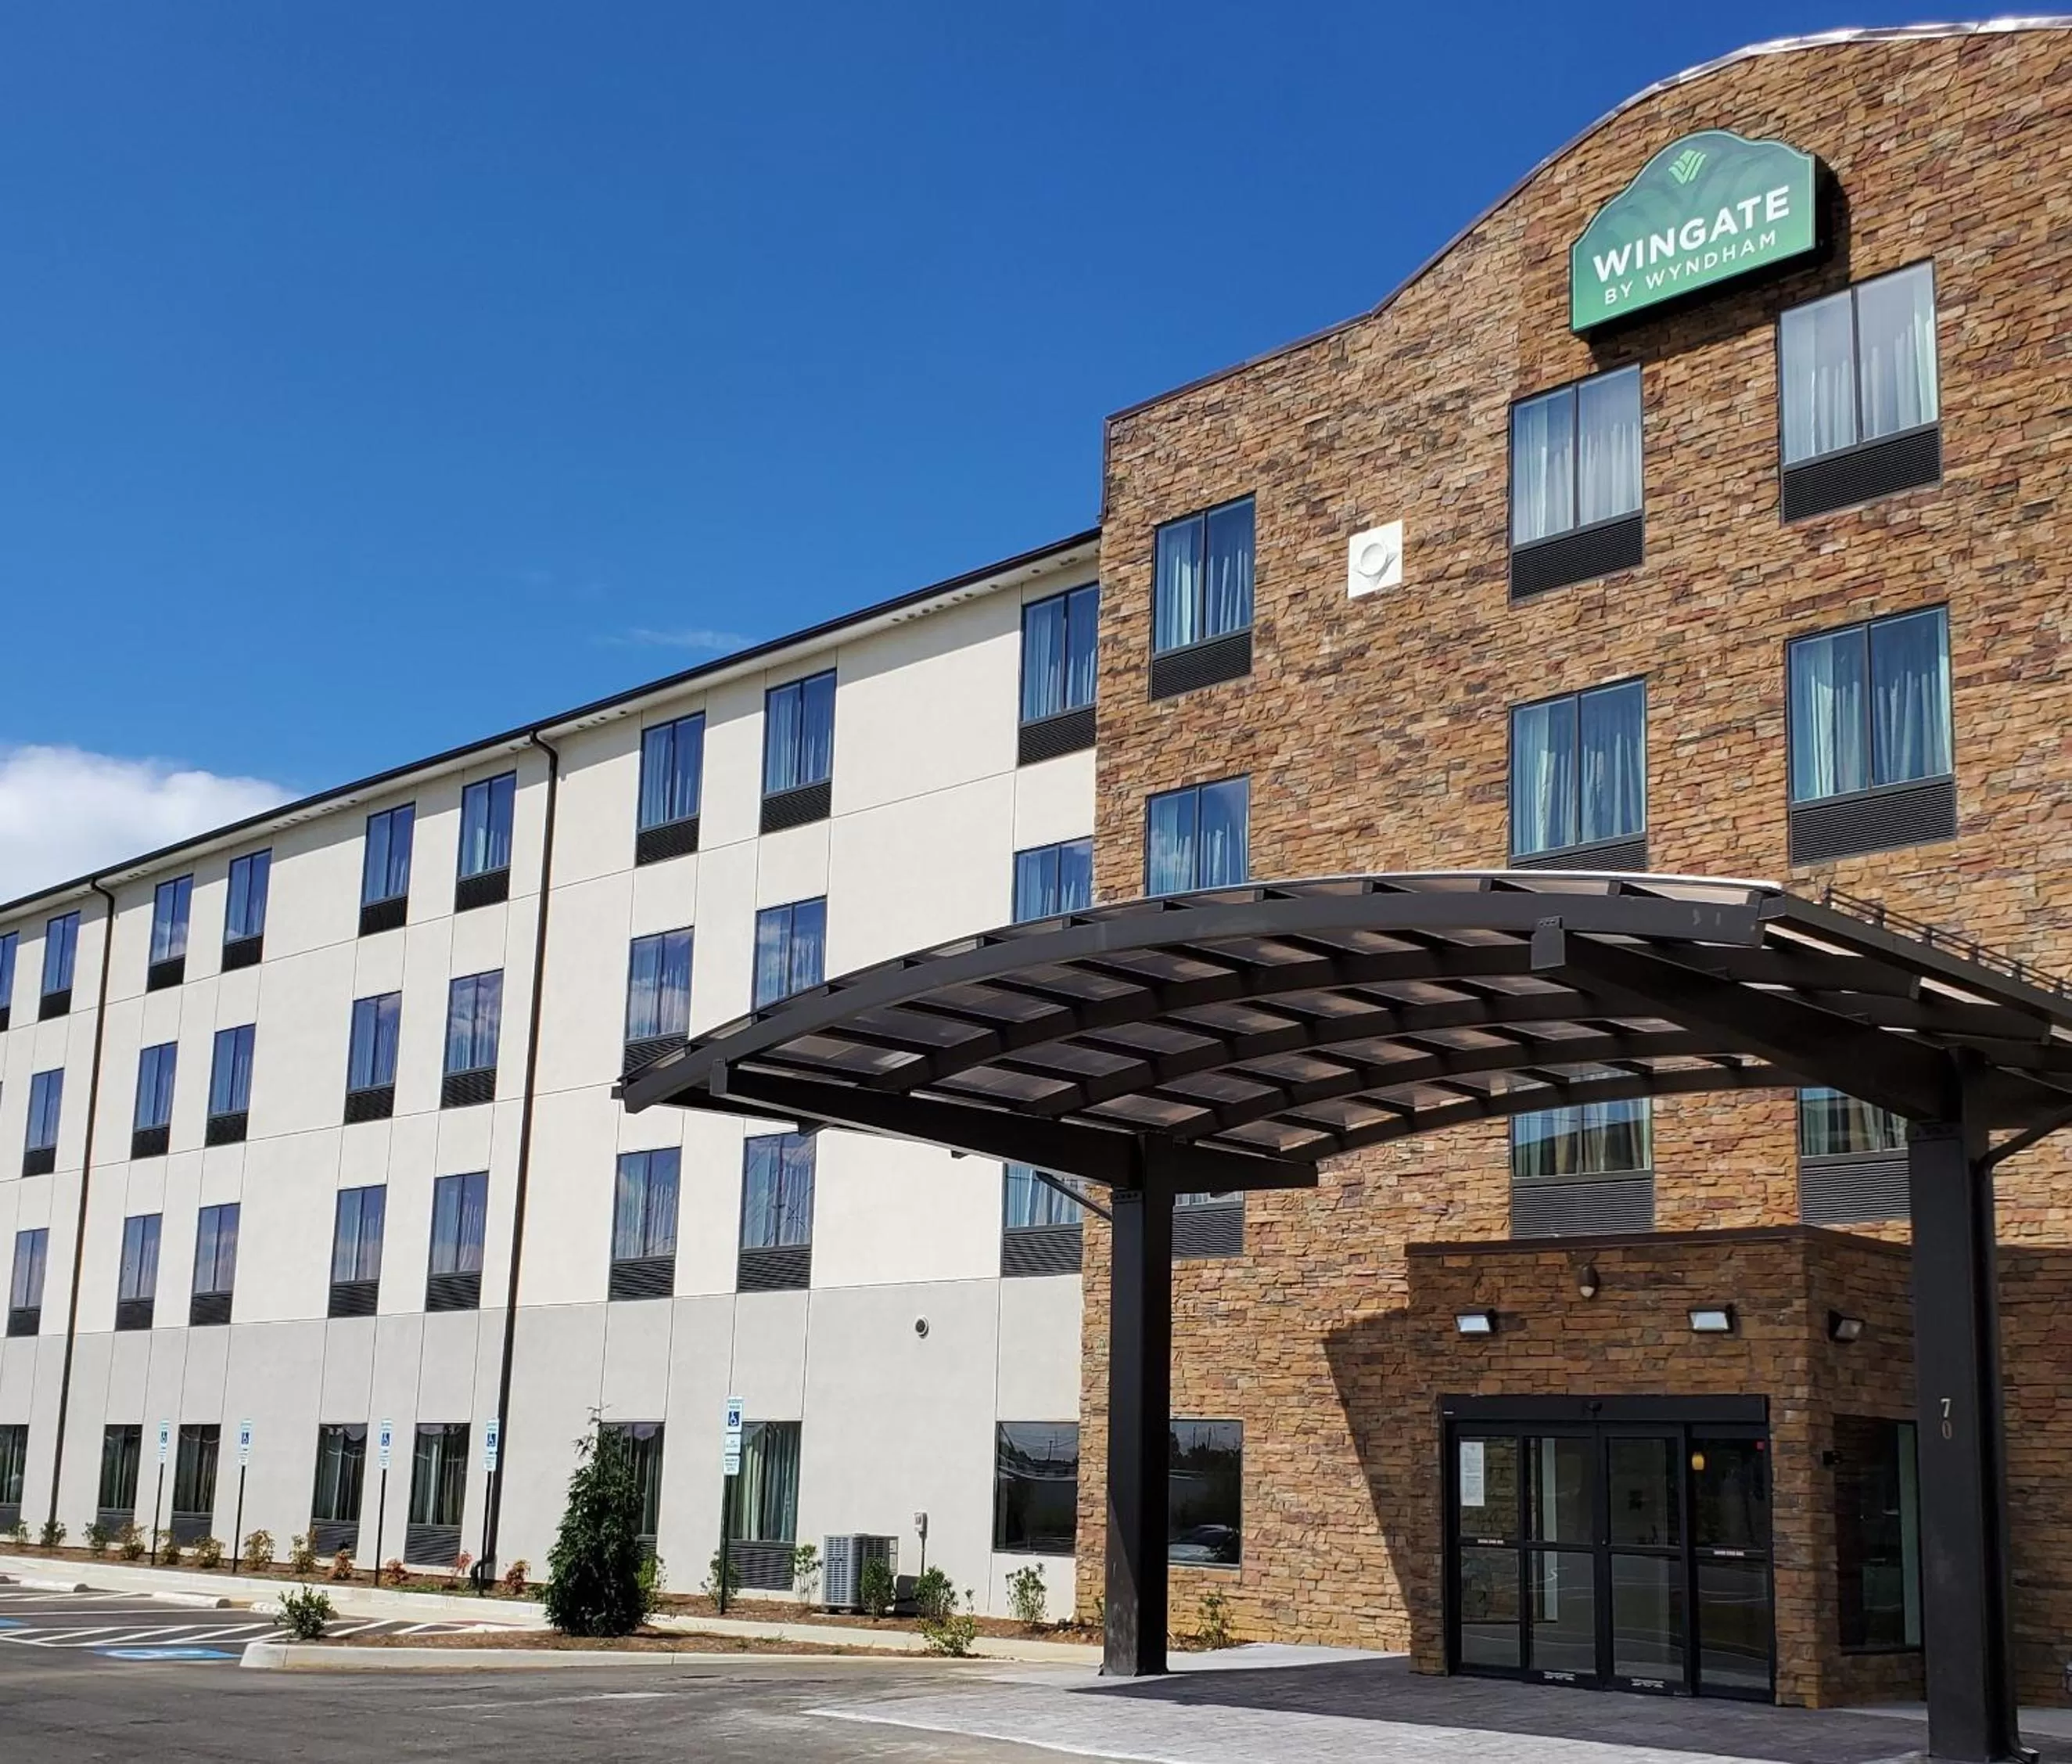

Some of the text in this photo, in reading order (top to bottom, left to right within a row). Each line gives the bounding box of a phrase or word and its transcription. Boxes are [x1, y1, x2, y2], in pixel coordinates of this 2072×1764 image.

[1593, 185, 1790, 282] WINGATE
[1604, 230, 1776, 306] BY WYNDHAM
